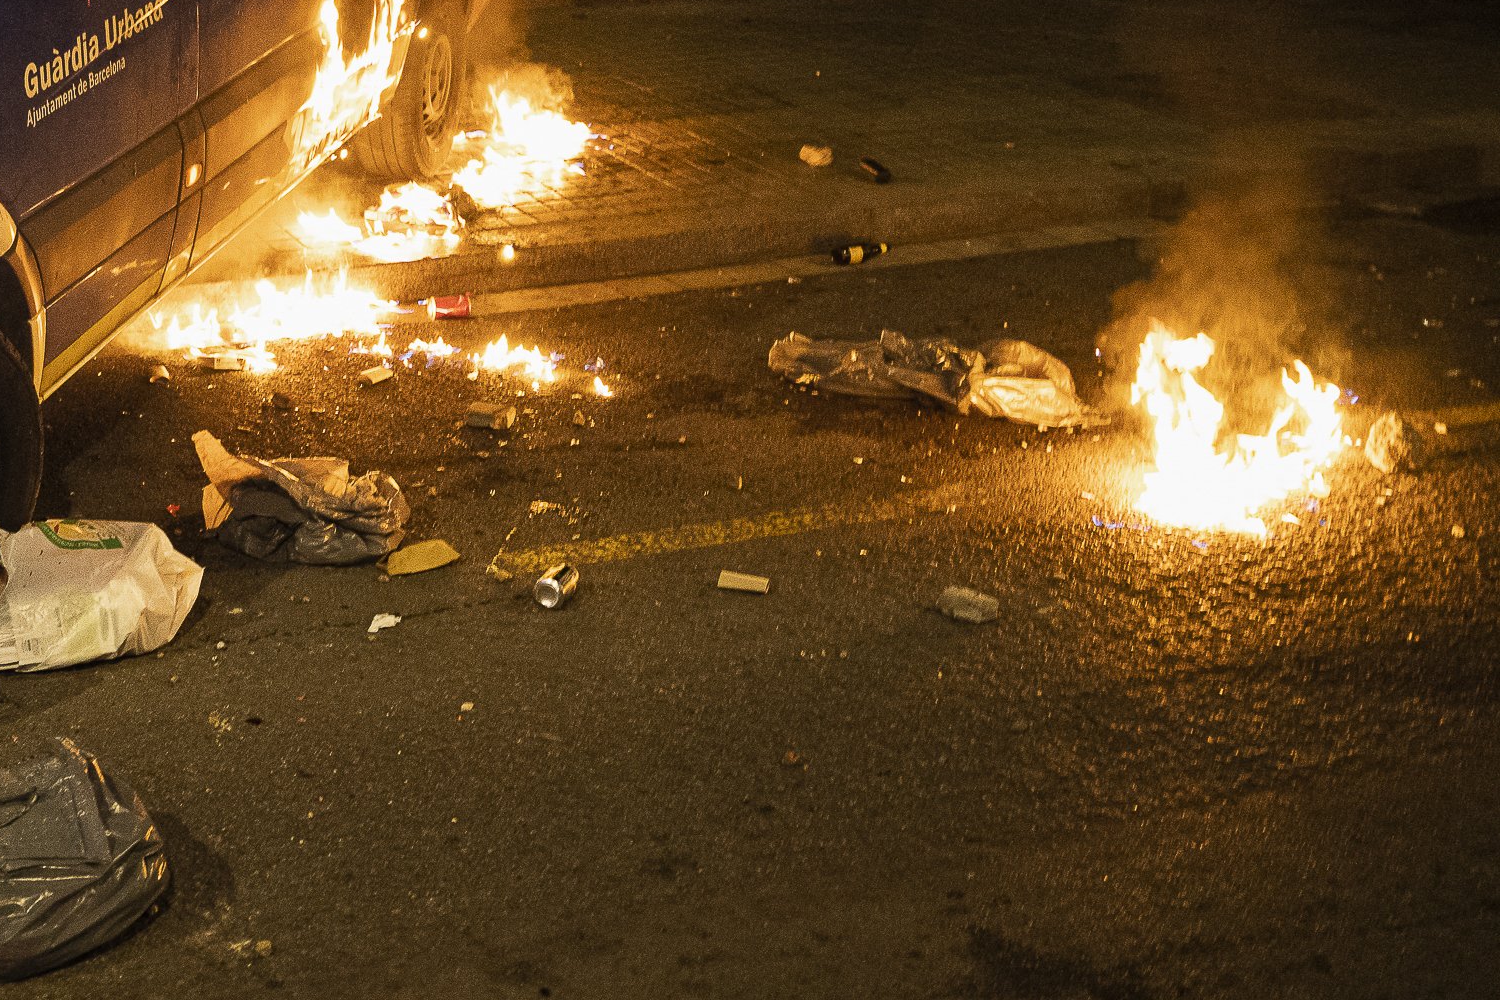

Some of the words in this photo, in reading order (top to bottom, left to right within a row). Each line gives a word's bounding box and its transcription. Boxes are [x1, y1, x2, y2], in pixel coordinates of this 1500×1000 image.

[24, 33, 100, 99] Guàrdia
[26, 83, 77, 128] Ajuntament
[77, 78, 88, 96] de
[88, 56, 126, 89] Barcelona
